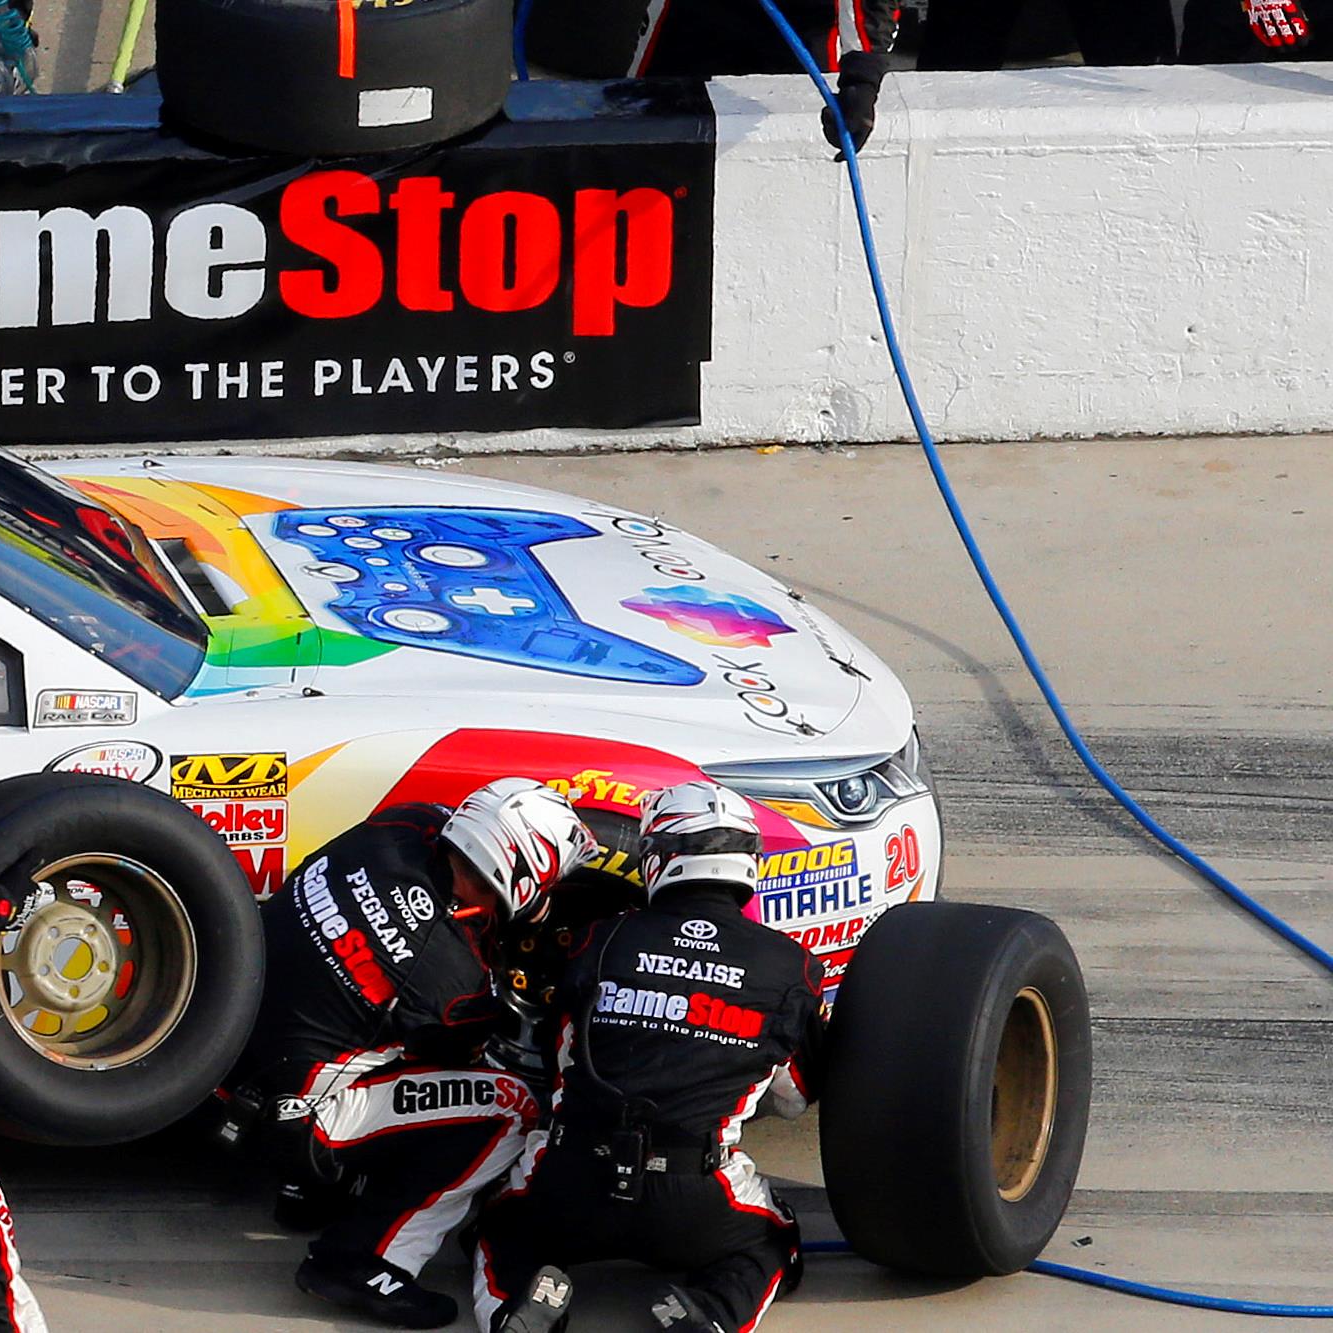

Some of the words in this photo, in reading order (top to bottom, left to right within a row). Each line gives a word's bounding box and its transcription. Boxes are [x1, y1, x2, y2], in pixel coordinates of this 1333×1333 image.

[92, 365, 161, 402] TO
[186, 361, 285, 400] THE
[313, 353, 555, 396] PLAYERS
[42, 712, 89, 722] RACE
[91, 711, 127, 722] CAR
[75, 695, 120, 710] NASCAR
[104, 748, 148, 761] NASCAR
[171, 786, 244, 799] MECHANIX
[245, 783, 286, 798] WEAR
[757, 839, 854, 881] MOOG
[757, 876, 793, 892] TEERING
[804, 865, 853, 885] SUSPENSION
[884, 823, 920, 895] 20
[345, 867, 415, 964] PEGRAM
[390, 885, 419, 932] TOYOTA
[763, 873, 873, 924] MAHLE
[302, 855, 399, 1006] GameStop
[673, 936, 721, 953] TOYOTA
[636, 951, 747, 990] NECAISE
[592, 1015, 637, 1027] power
[641, 1019, 659, 1030] to
[663, 1021, 690, 1036] the
[596, 980, 767, 1039] GameStop
